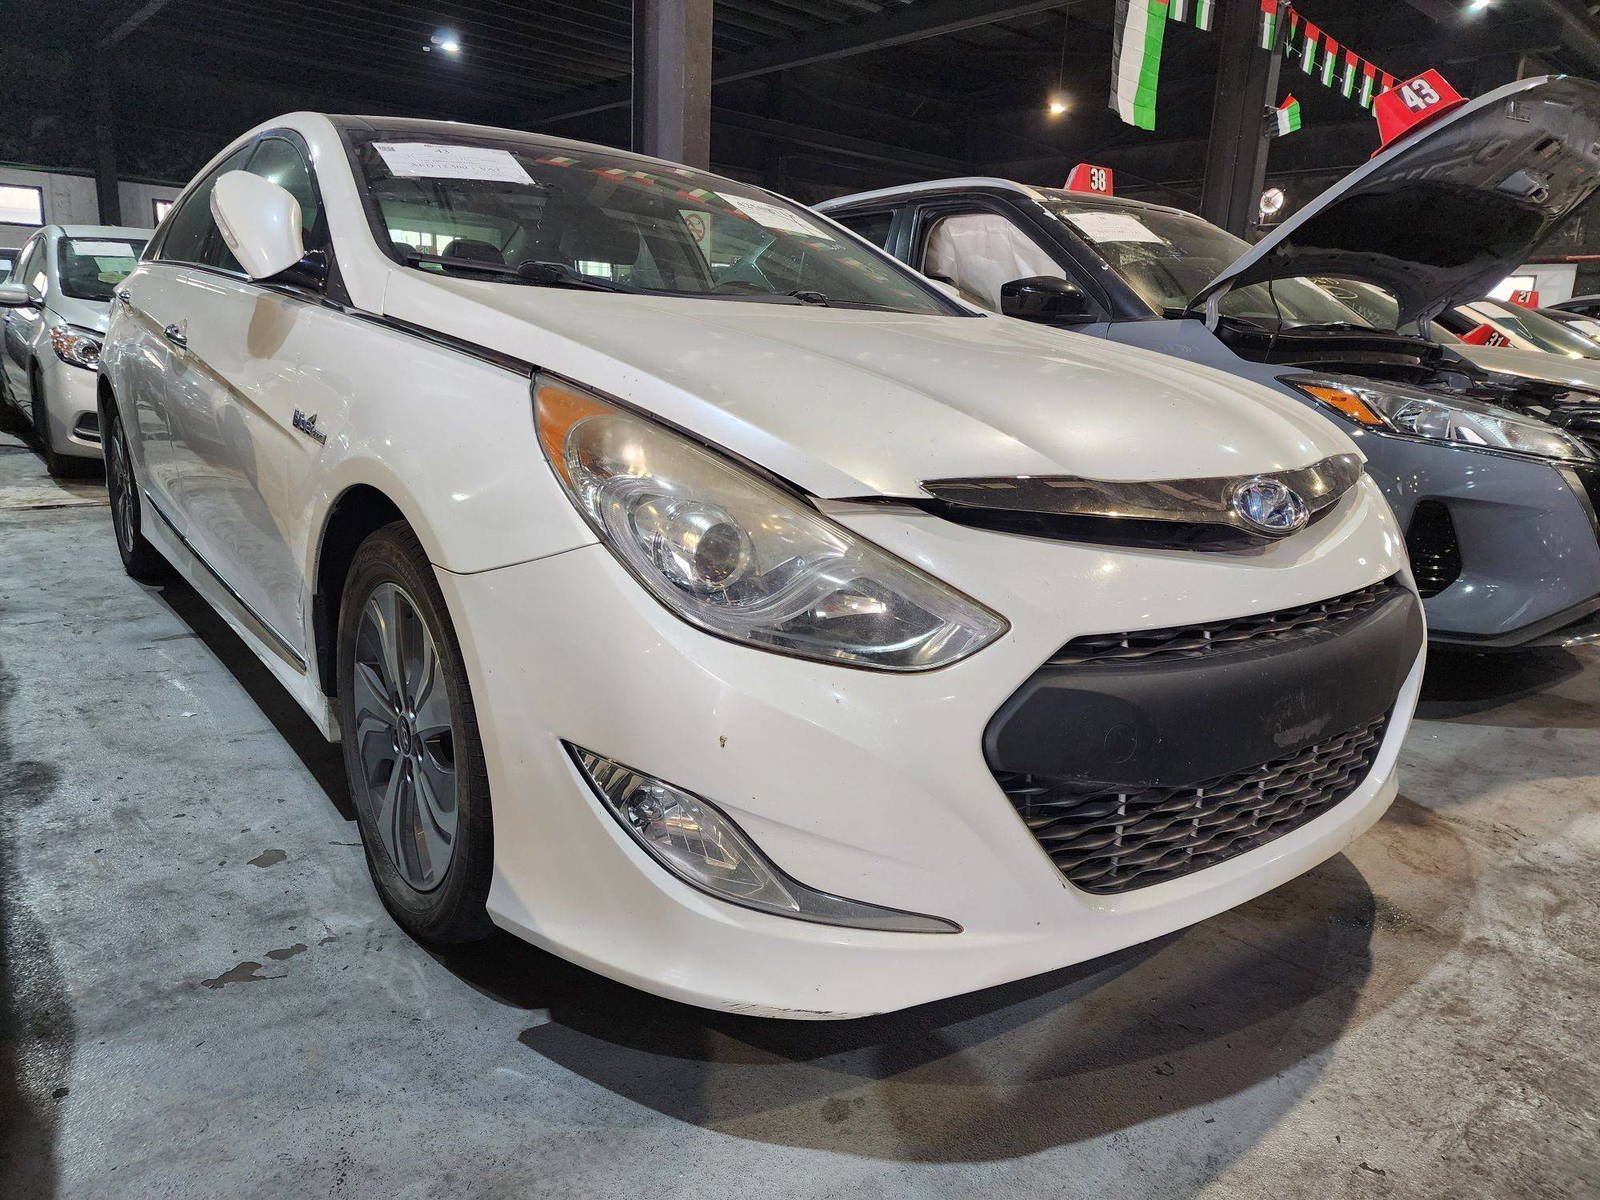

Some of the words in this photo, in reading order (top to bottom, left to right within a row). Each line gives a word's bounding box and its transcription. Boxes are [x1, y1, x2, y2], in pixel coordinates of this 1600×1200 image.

[1401, 79, 1440, 110] 43
[1090, 167, 1106, 192] 38
[1517, 290, 1532, 303] 21
[1485, 331, 1505, 348] 31
